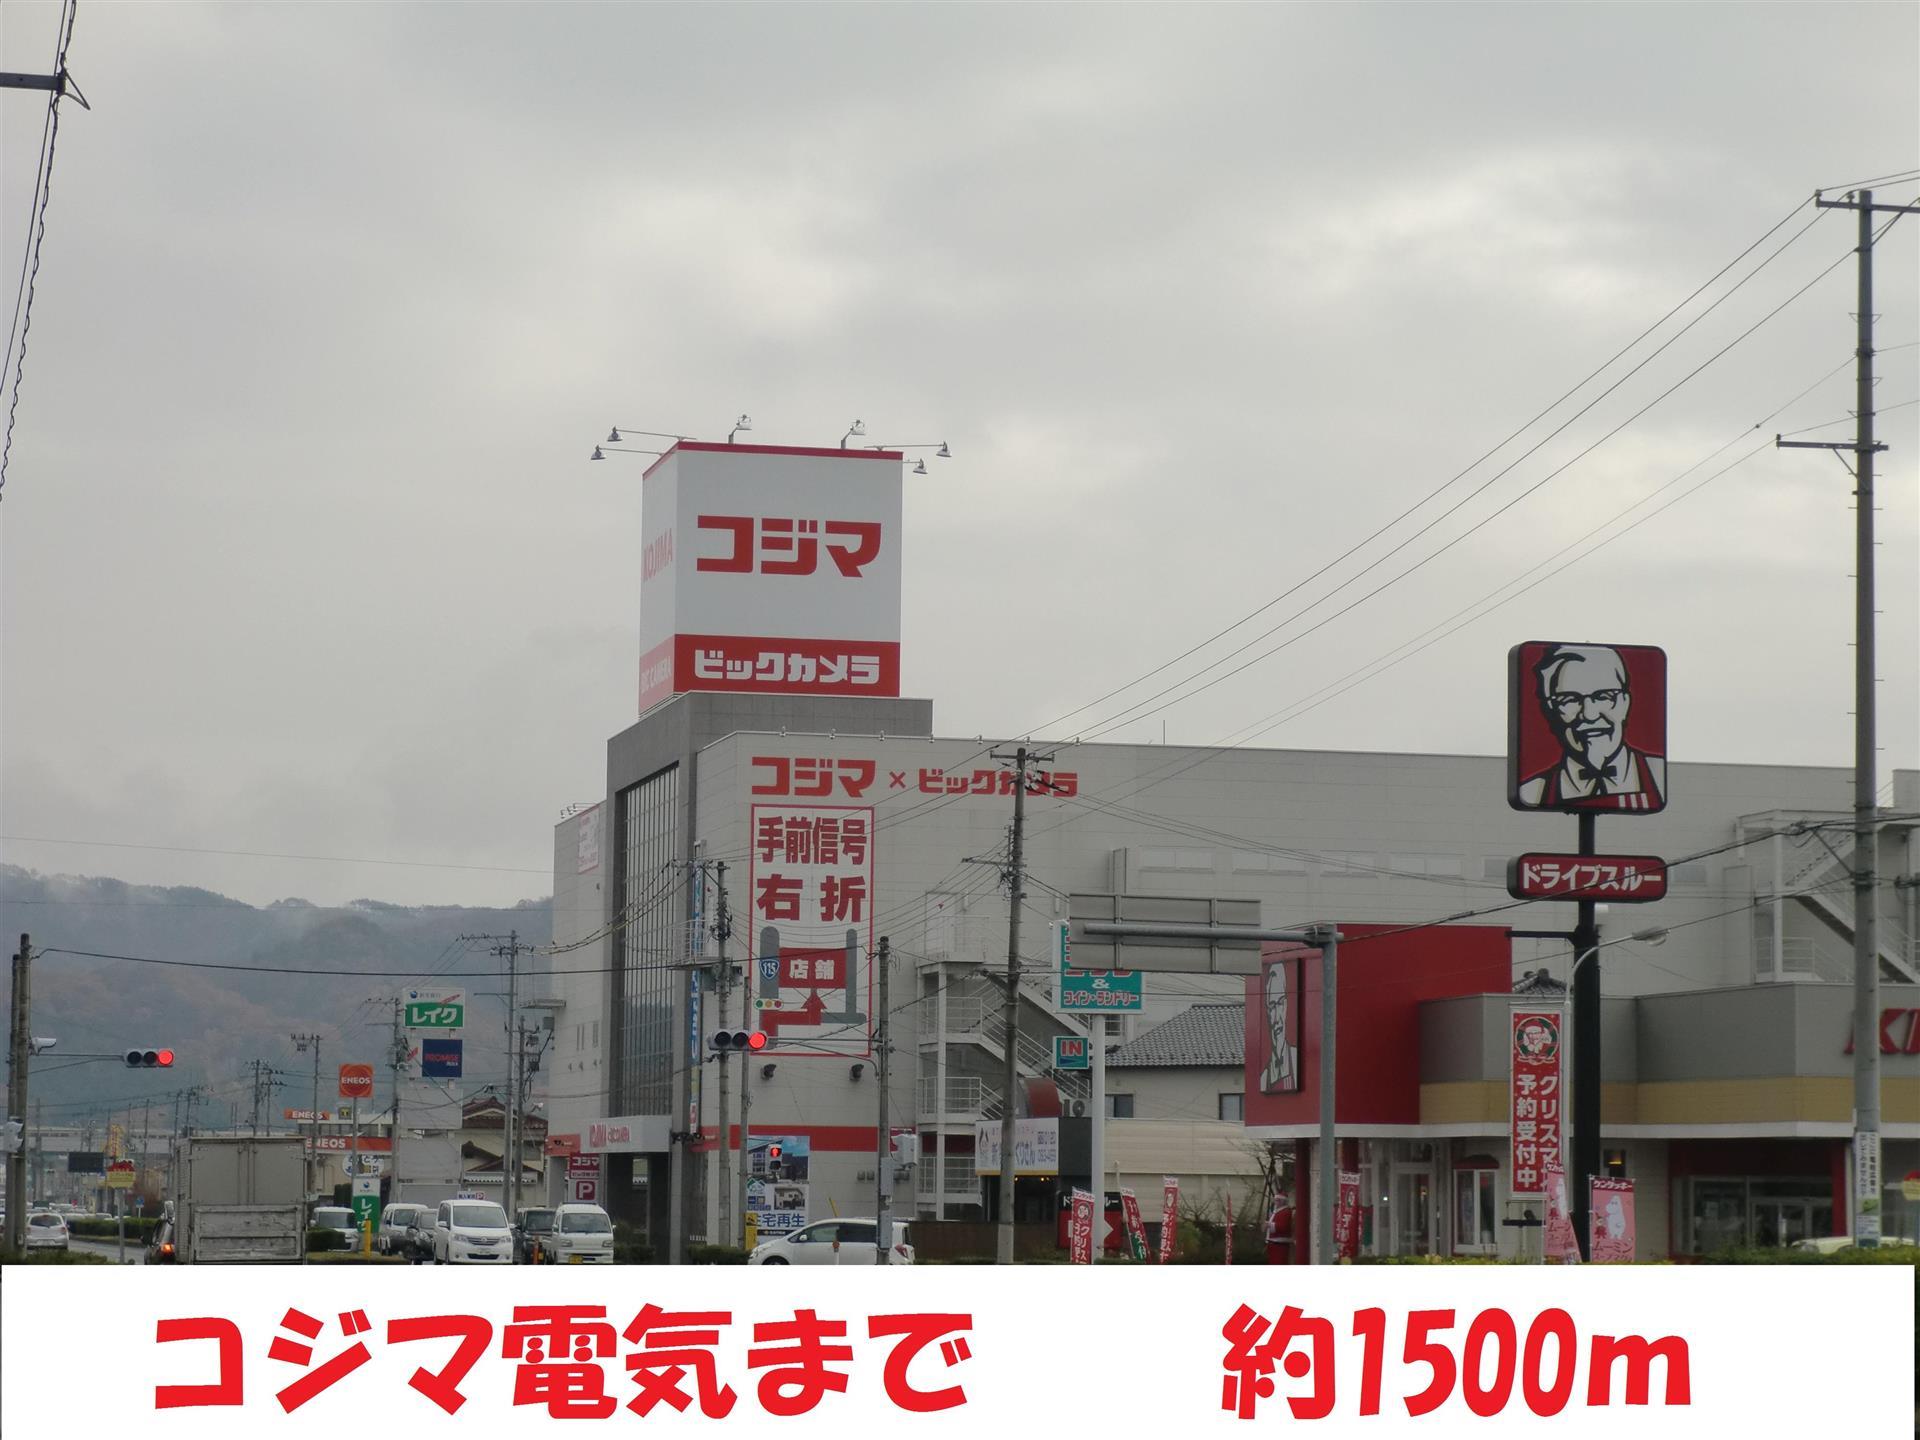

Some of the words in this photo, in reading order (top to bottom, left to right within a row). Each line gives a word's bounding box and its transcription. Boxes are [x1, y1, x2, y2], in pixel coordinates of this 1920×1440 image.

[697, 515, 881, 577] コジマ
[694, 649, 880, 684] ビックカメラ
[752, 757, 876, 797] コジマ
[757, 816, 867, 864] 手前信号
[1523, 862, 1662, 891] ドライブスルー
[756, 874, 866, 922] 右折
[761, 961, 777, 976] 115
[789, 959, 834, 980] 店舗
[412, 1007, 457, 1024] レイク
[1061, 1040, 1083, 1056] IN
[1515, 1074, 1537, 1188] 予約受付中
[572, 1156, 599, 1167] コジマ
[579, 1182, 593, 1199] P
[756, 1213, 805, 1228] 宅再生
